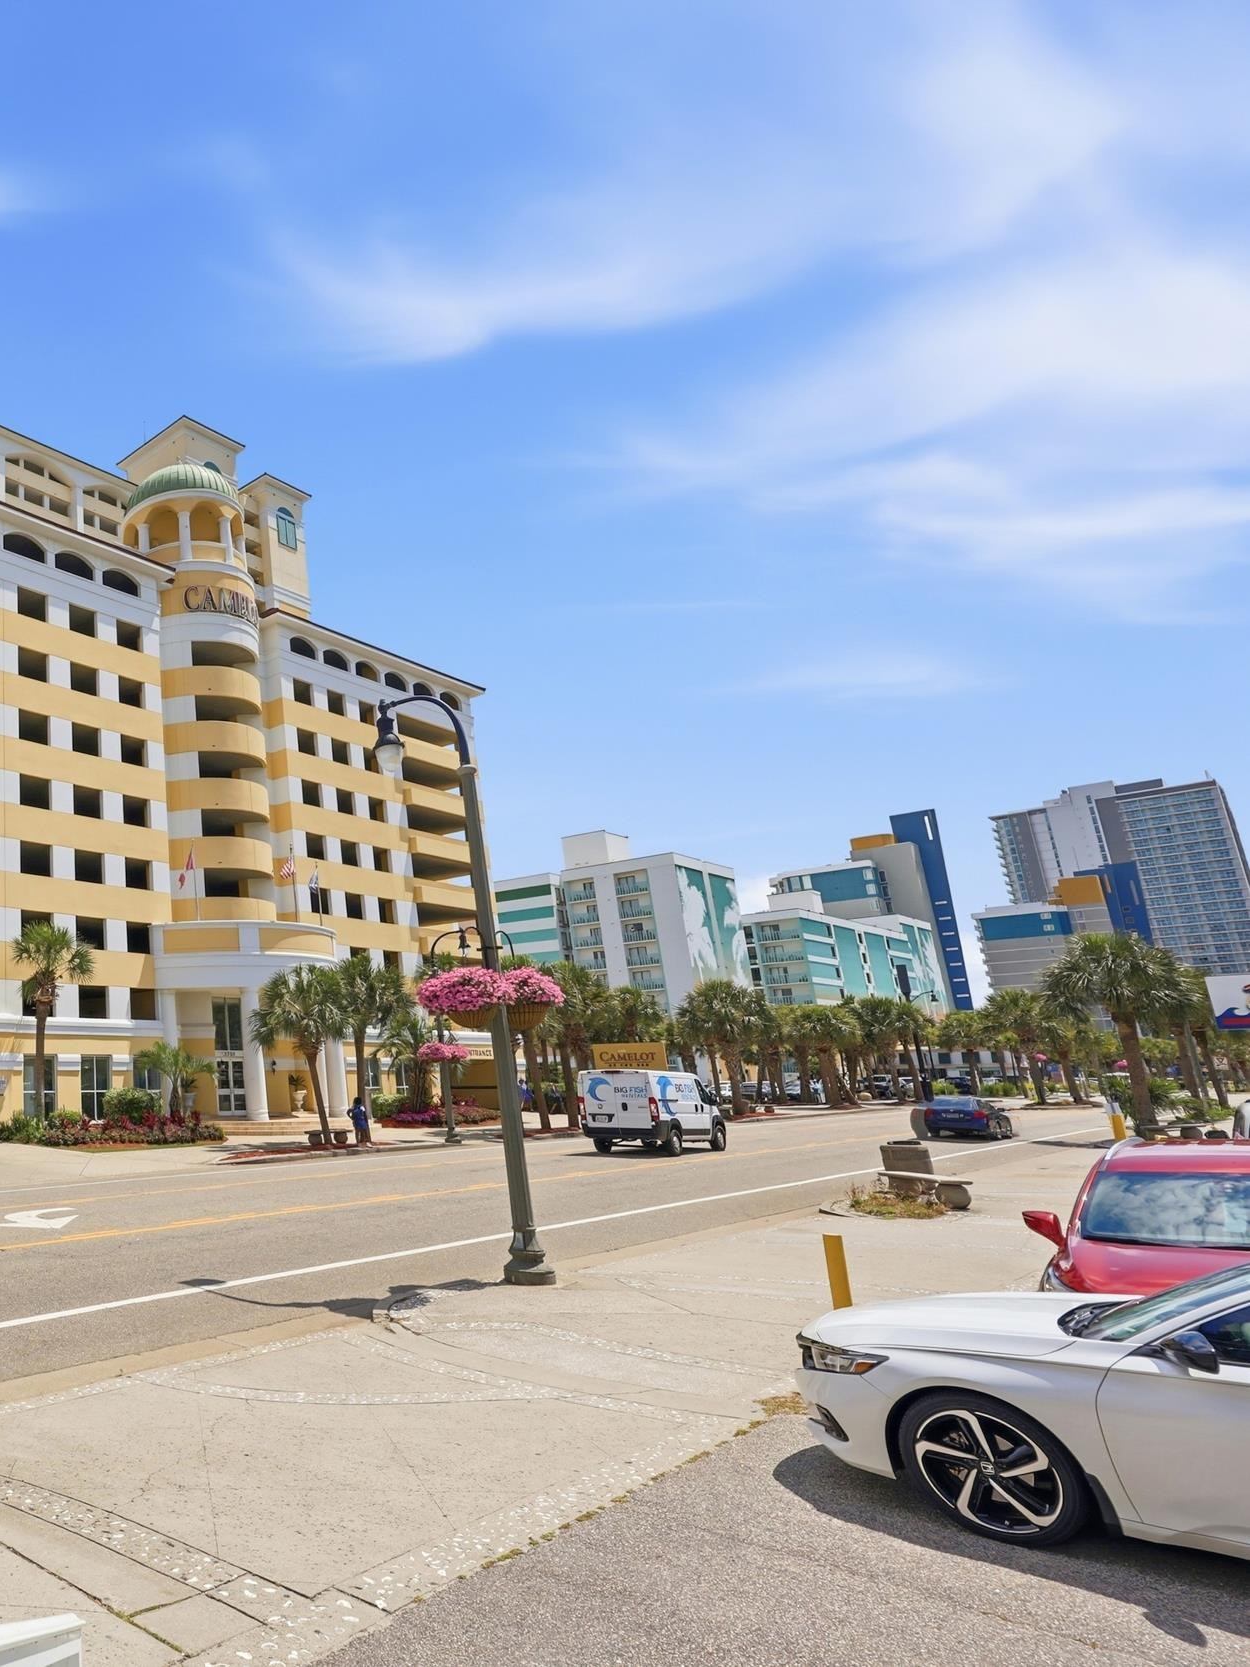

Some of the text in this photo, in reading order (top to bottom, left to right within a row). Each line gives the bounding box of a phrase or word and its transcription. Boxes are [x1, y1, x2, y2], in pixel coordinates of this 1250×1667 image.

[468, 1049, 492, 1057] NTRANCE
[599, 1051, 656, 1062] CAMELOT
[629, 1085, 648, 1093] FISH
